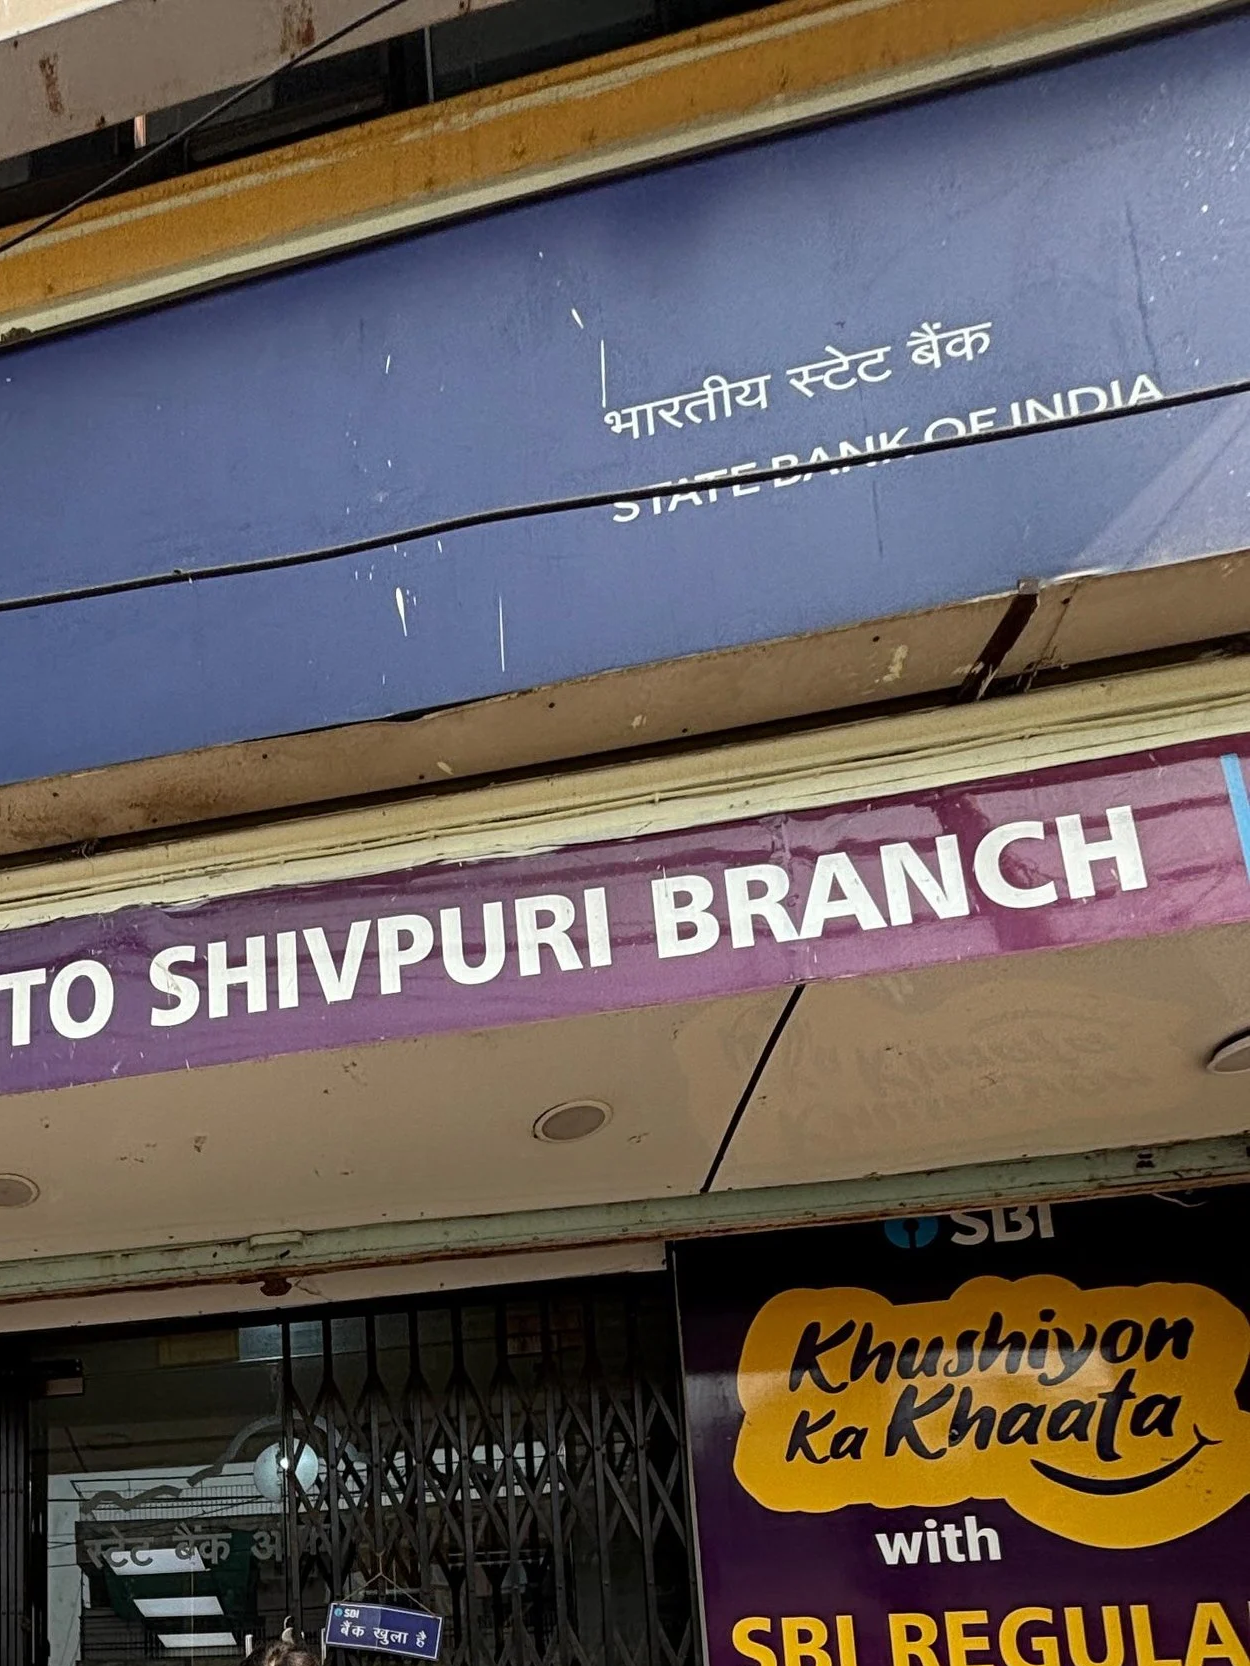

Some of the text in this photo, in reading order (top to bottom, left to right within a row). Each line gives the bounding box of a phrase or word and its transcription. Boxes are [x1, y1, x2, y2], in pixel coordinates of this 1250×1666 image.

[604, 320, 992, 439] भारतीय स्टेट बैंक
[149, 887, 611, 1028] SHIVPURI
[649, 805, 1150, 960] BRANCH
[950, 1203, 1055, 1246] SBI
[788, 1308, 1195, 1395] Khushiyon
[785, 1369, 1184, 1464] Ka Khaata
[874, 1515, 1002, 1567] with
[340, 1620, 427, 1648] बैंक खुला है
[344, 1608, 360, 1619] SBI
